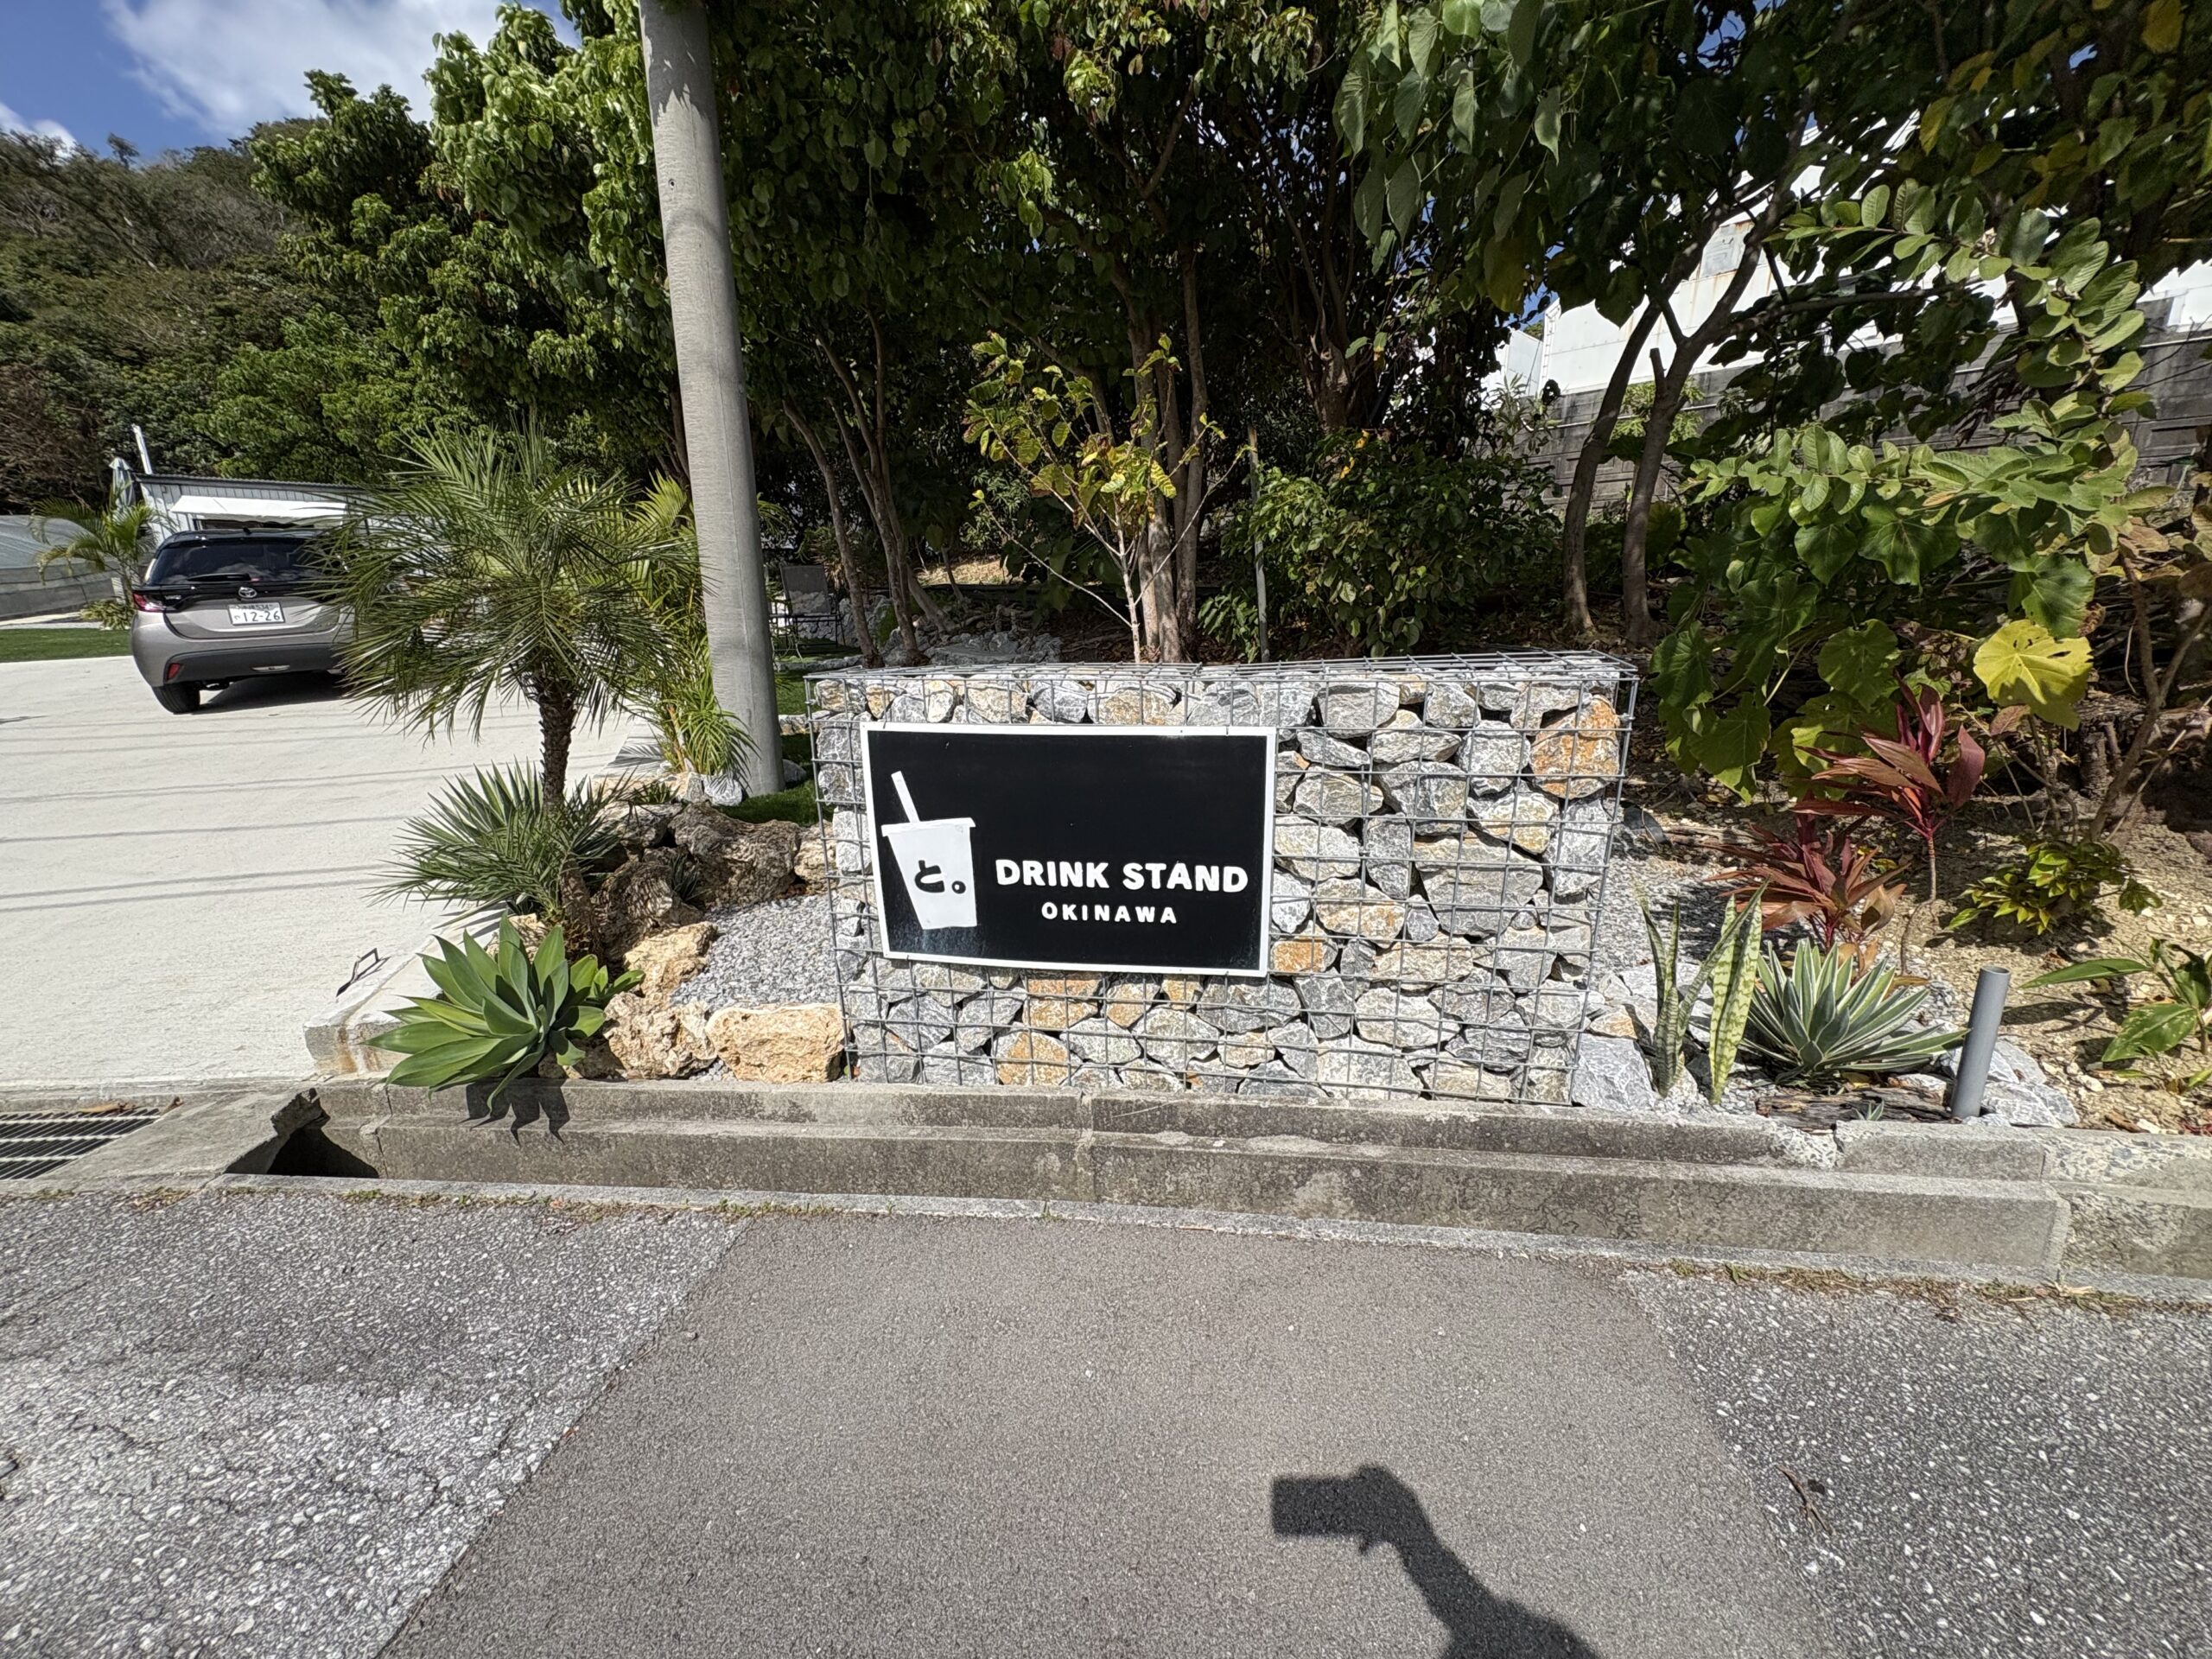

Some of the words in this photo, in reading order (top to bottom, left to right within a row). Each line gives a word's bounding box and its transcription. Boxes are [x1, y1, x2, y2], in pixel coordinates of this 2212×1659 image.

[243, 610, 280, 622] 12-26
[995, 859, 1110, 889] DRINK
[1122, 861, 1249, 893] STAND
[1041, 901, 1177, 924] OKINAWA
